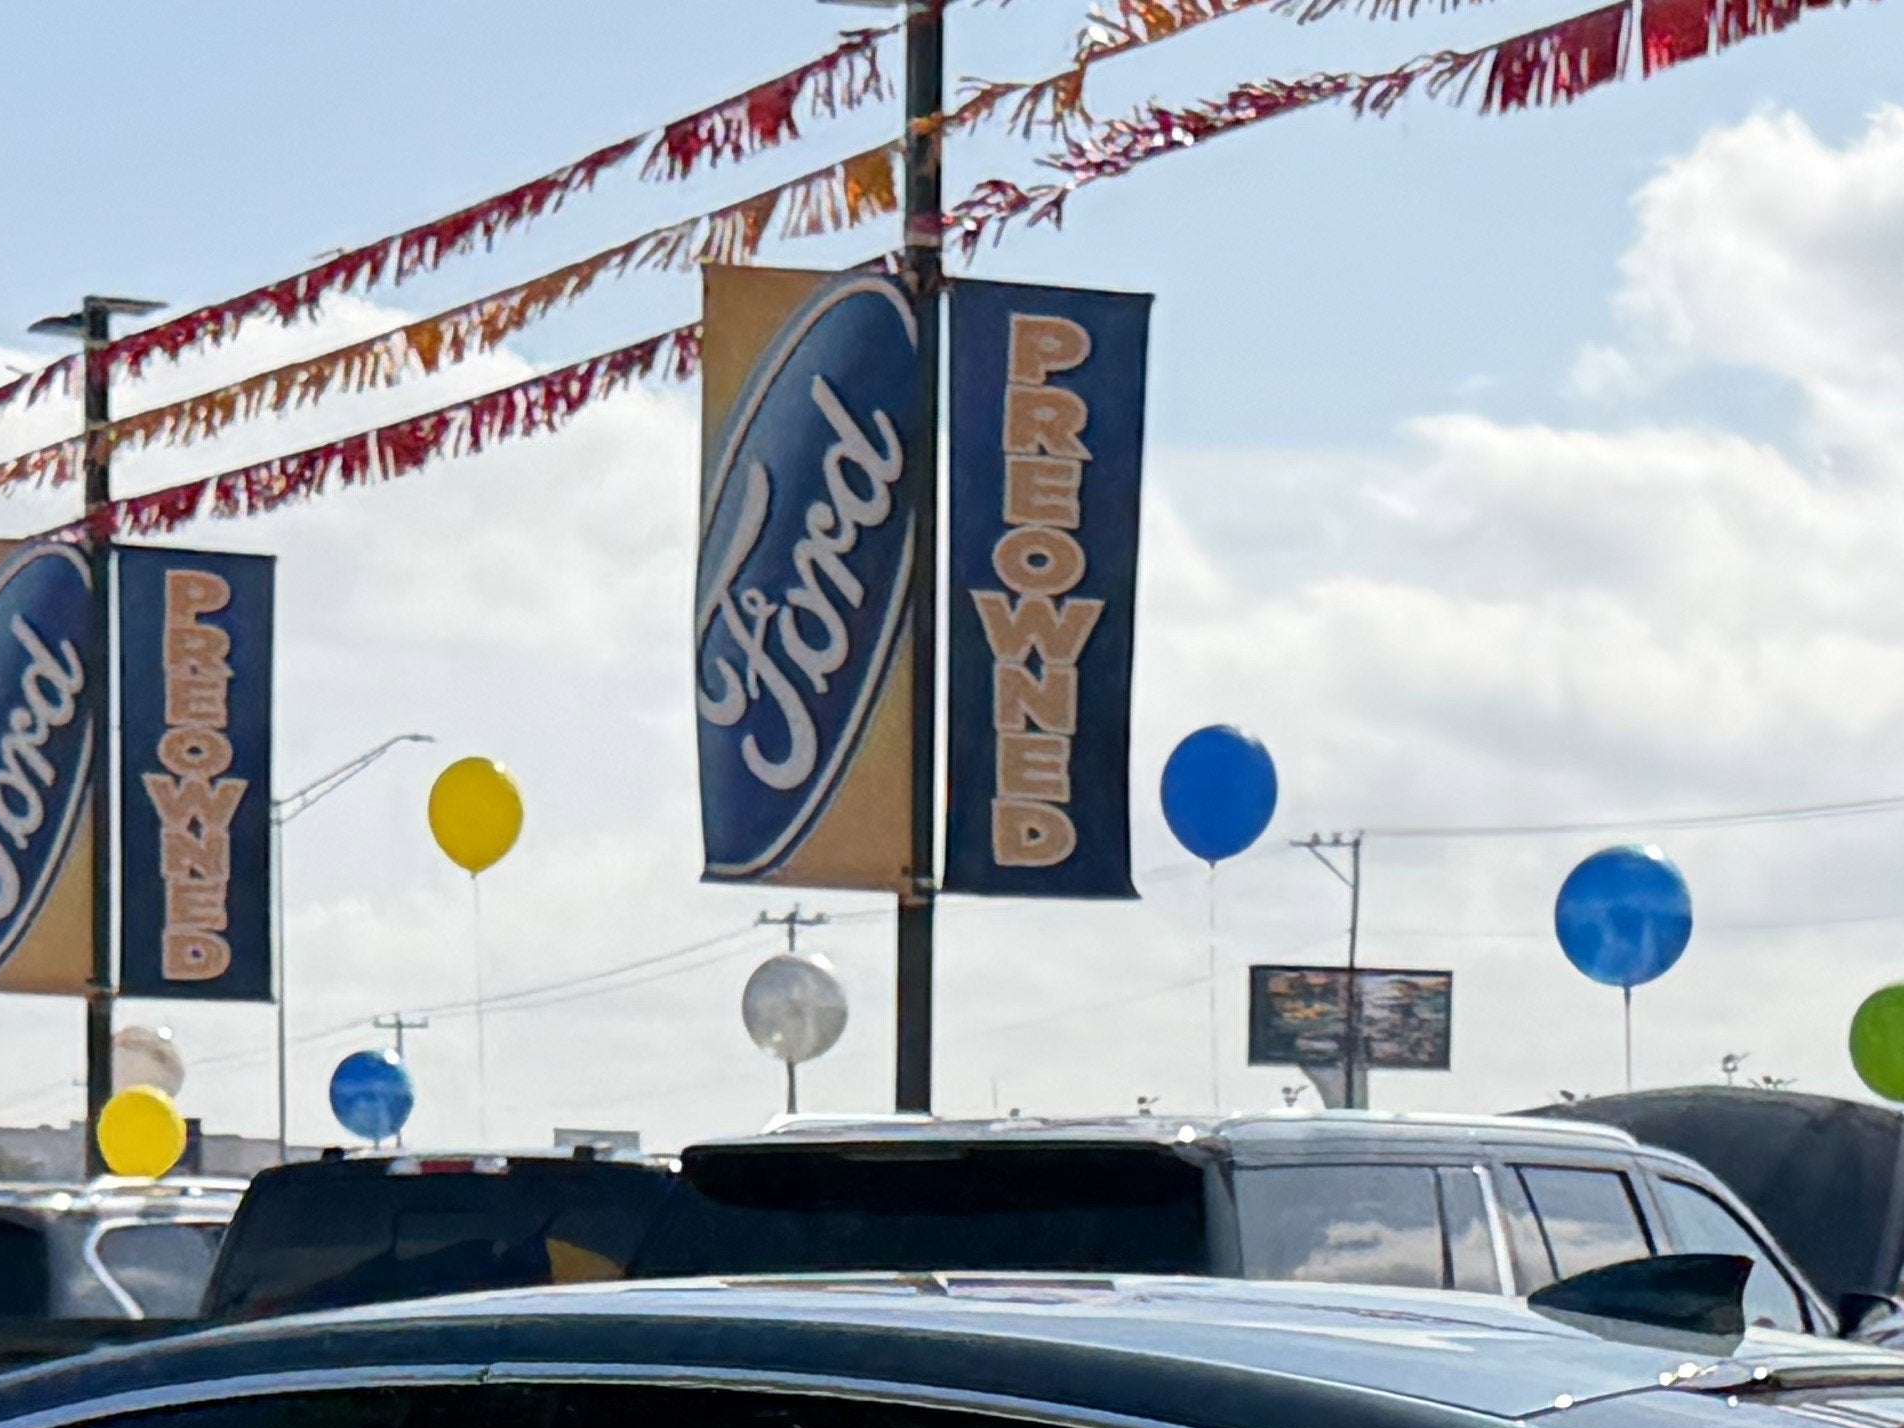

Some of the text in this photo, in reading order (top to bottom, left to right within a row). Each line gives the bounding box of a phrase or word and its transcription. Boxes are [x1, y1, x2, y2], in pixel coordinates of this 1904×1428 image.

[141, 569, 248, 980] PREOWNED
[696, 374, 904, 790] Ford
[970, 313, 1106, 867] PREOWNED
